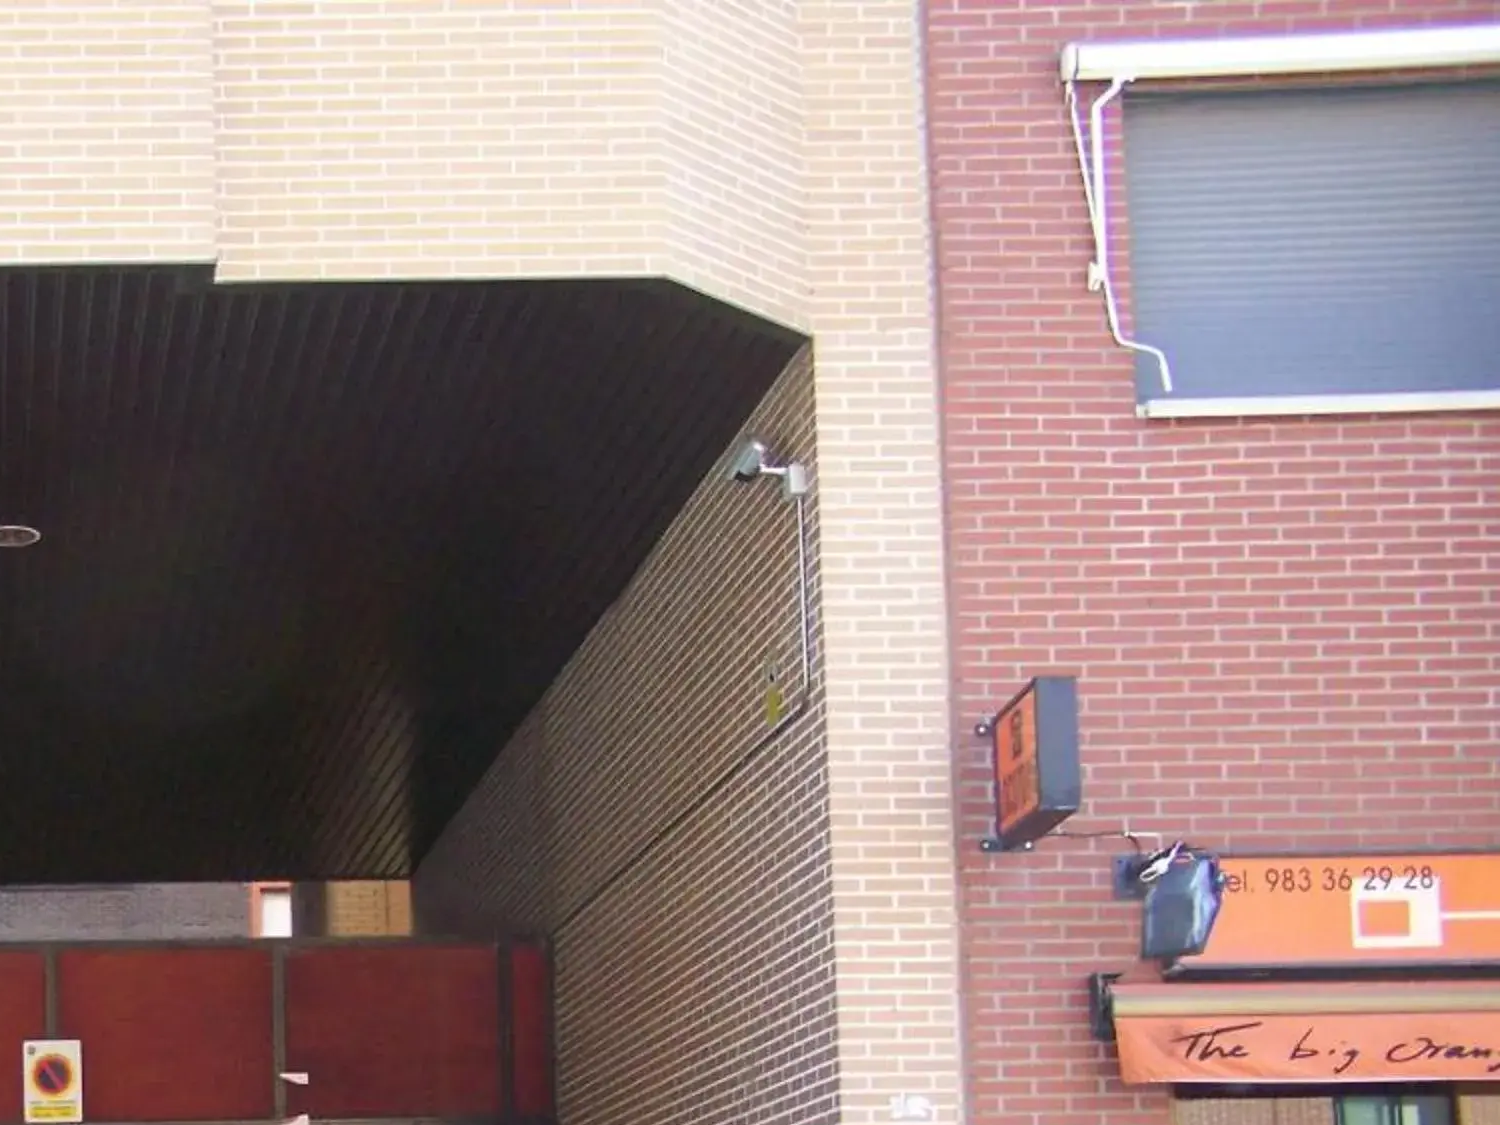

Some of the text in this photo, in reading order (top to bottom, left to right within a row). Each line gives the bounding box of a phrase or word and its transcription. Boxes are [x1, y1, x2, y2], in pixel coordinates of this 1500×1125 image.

[1221, 865, 1434, 893] el. 983 36 29 28
[1169, 1021, 1263, 1061] The
[1288, 1026, 1359, 1074] big
